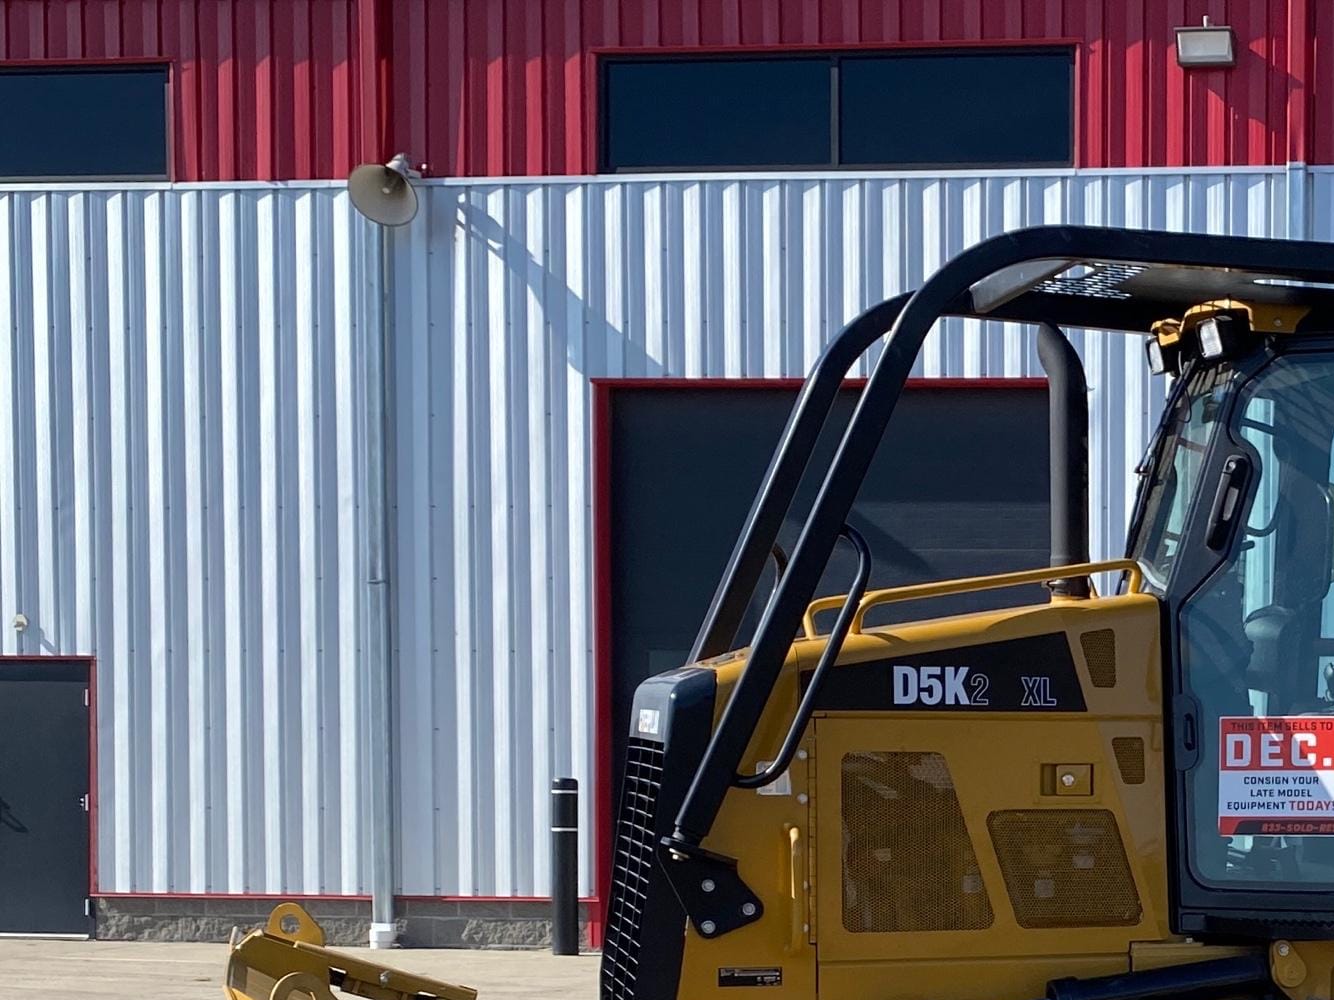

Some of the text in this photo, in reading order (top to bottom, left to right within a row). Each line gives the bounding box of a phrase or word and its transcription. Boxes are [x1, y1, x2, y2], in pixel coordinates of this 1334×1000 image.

[1020, 676, 1057, 706] XL
[1231, 722, 1254, 731] THIS
[1258, 722, 1282, 731] ITEM
[1285, 722, 1317, 731] SELLS
[1319, 722, 1333, 731] TO
[1226, 733, 1332, 767] DEC.
[1243, 776, 1319, 785] CONSIGN YOUR
[1250, 789, 1312, 798] LATE MODEL
[1227, 801, 1286, 811] EQUIPMENT
